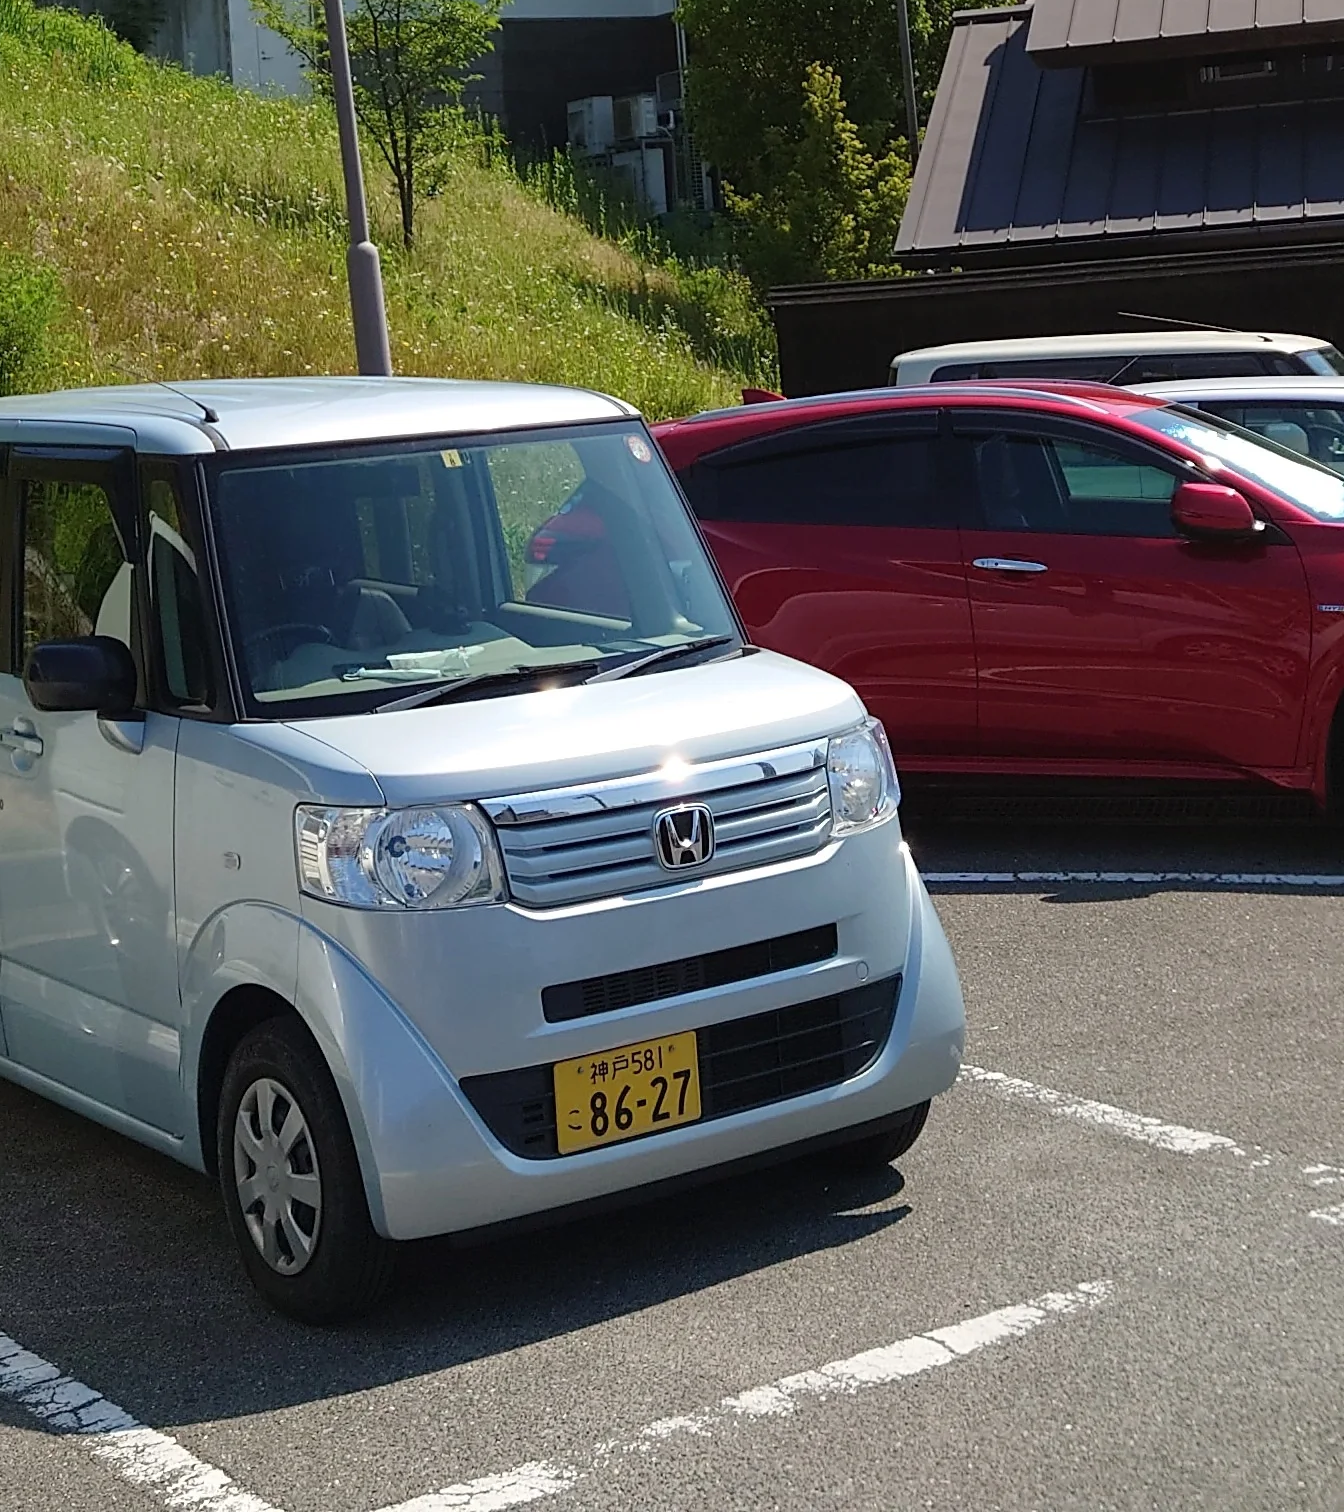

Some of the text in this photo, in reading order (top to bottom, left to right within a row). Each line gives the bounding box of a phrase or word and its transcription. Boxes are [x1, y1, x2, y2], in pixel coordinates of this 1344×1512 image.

[590, 1045, 664, 1085] 神戸581
[568, 1069, 691, 1137] こ 86-27
